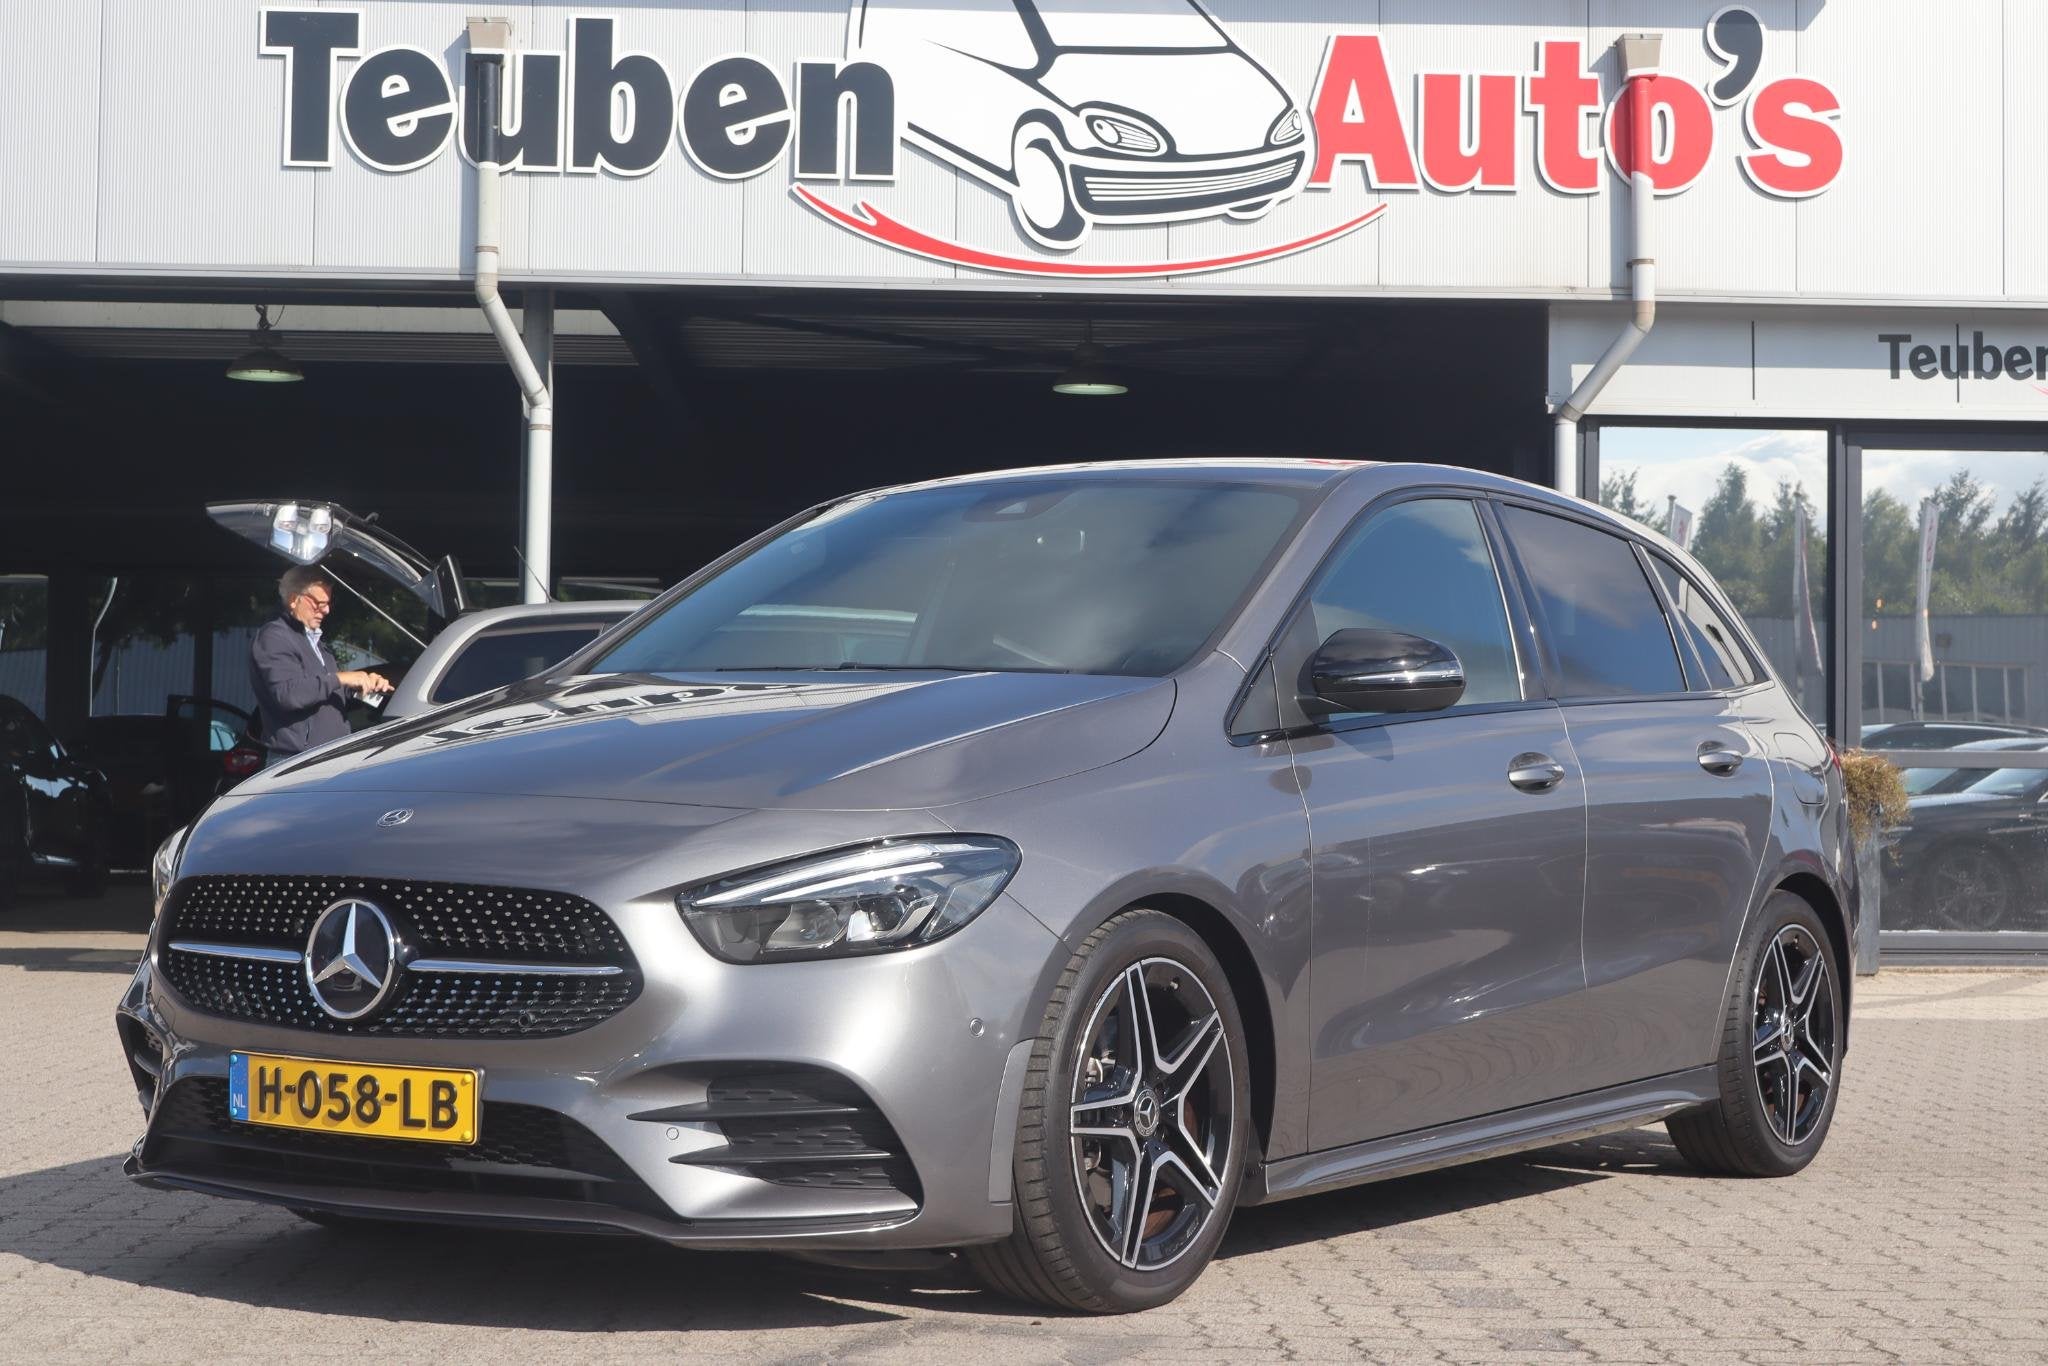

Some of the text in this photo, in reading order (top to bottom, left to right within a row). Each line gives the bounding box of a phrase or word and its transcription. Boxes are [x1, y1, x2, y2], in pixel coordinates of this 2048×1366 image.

[260, 6, 1843, 199] Teuben Auto's
[232, 1093, 246, 1108] NL
[258, 1065, 458, 1129] H-058-LB
